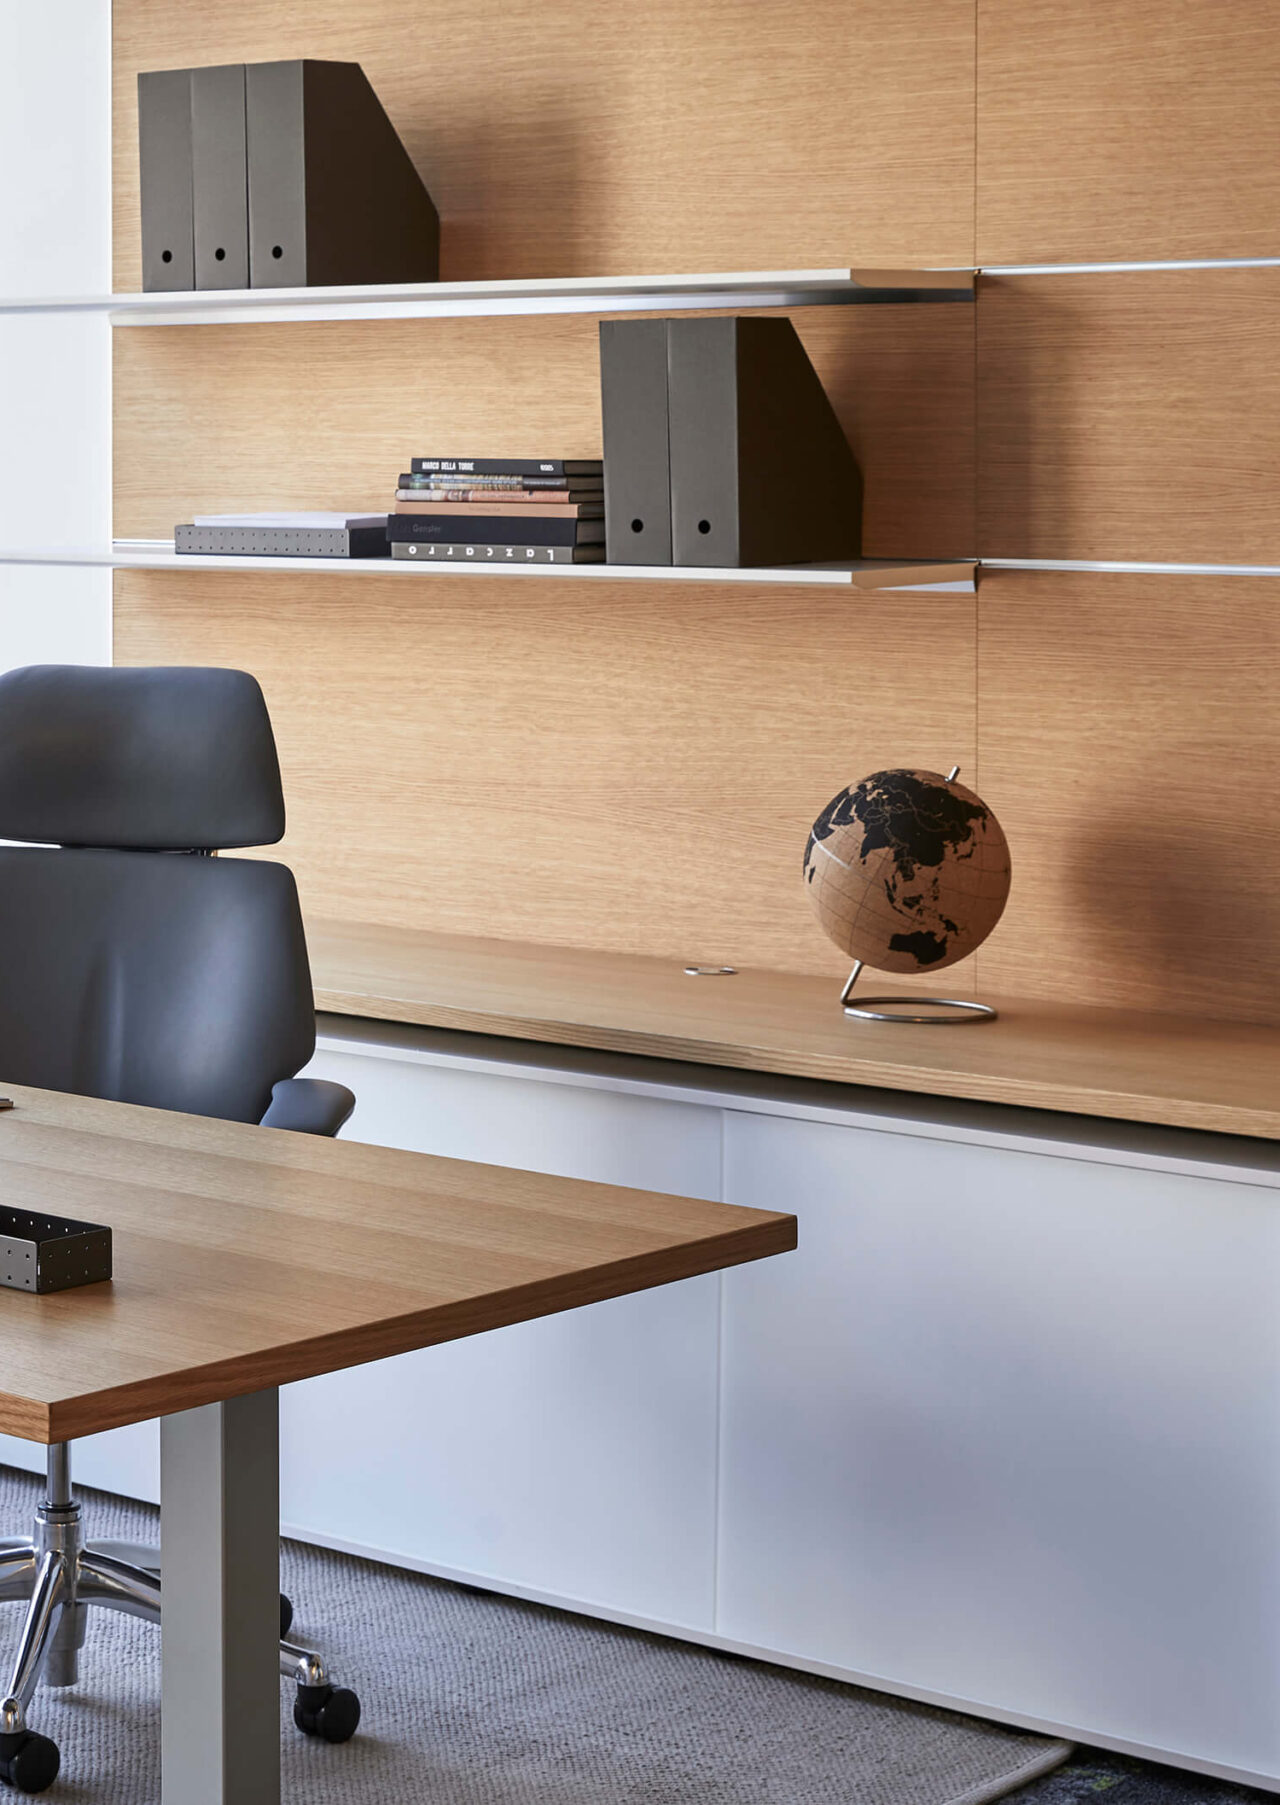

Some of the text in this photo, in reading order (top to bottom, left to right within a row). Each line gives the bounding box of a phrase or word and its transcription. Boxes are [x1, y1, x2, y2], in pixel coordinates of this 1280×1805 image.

[422, 461, 474, 471] MARCO DELLA TORRE
